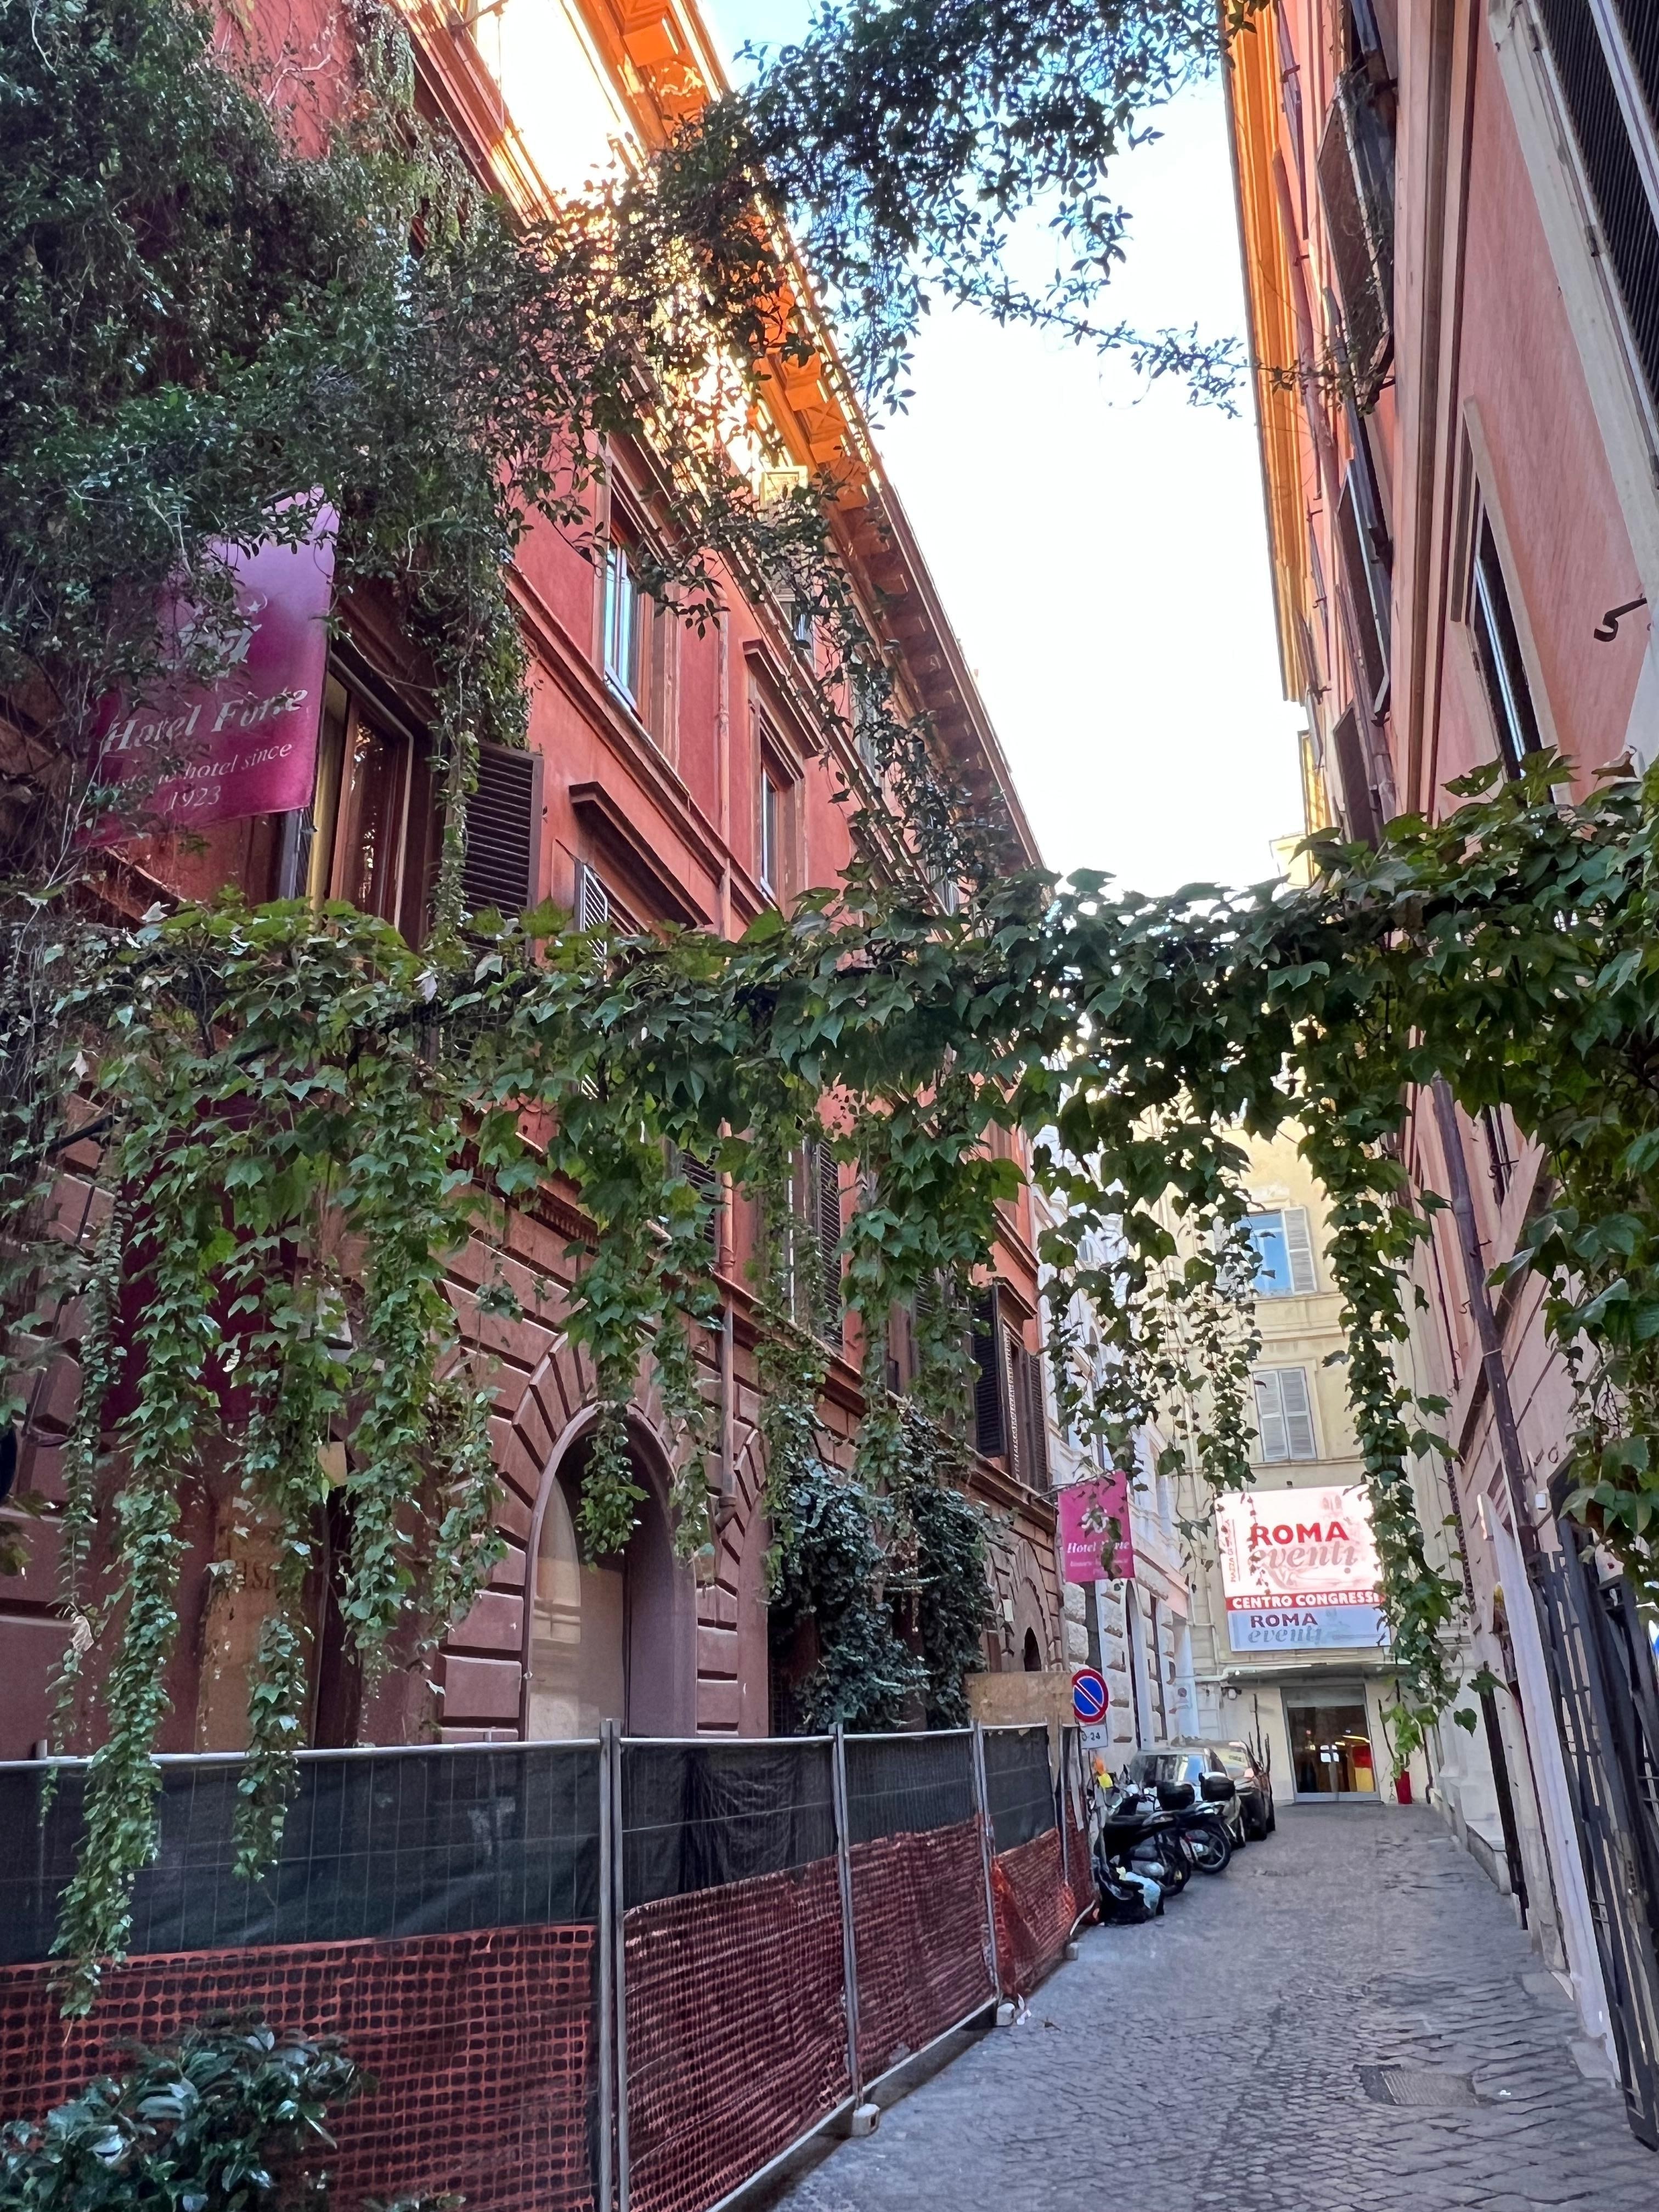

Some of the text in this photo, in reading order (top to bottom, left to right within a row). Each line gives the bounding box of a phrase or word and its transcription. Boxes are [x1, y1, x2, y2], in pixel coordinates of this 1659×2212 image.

[101, 704, 202, 755] Hotel
[184, 754, 238, 780] hotel
[241, 743, 292, 770] since
[169, 785, 221, 811] 1923
[1250, 1521, 1350, 1546] ROMA
[1067, 1541, 1097, 1554] Hotel
[1248, 1541, 1358, 1574] eventi
[1232, 1592, 1380, 1609] CENTRO CONGRESSI
[1250, 1613, 1318, 1628] ROMA
[1248, 1626, 1322, 1644] eventi
